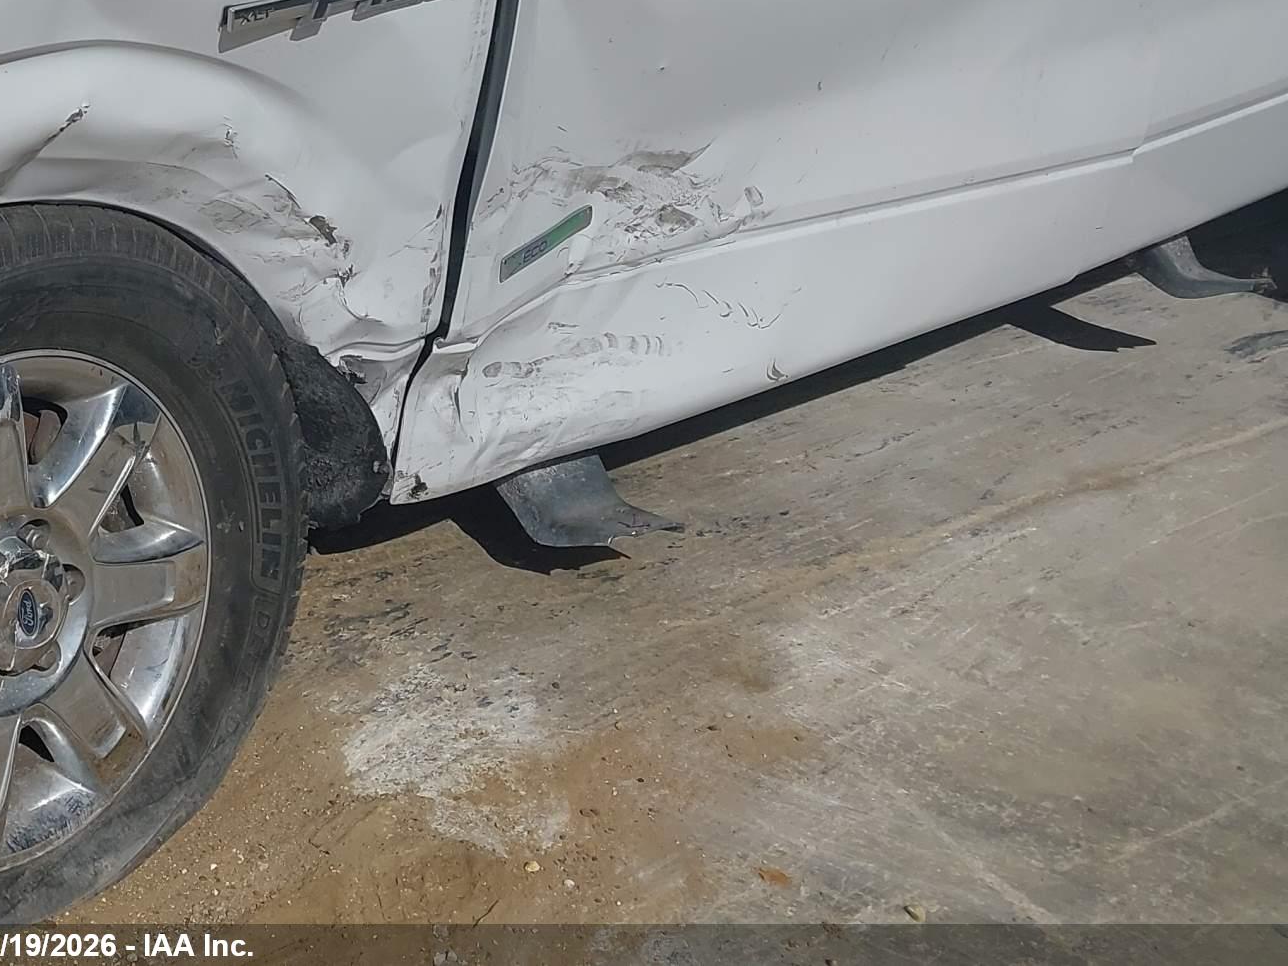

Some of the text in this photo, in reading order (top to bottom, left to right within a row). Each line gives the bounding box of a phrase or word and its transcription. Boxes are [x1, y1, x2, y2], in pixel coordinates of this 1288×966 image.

[238, 7, 274, 26] XLT
[219, 378, 284, 582] MICHELIN
[20, 599, 34, 627] Ford
